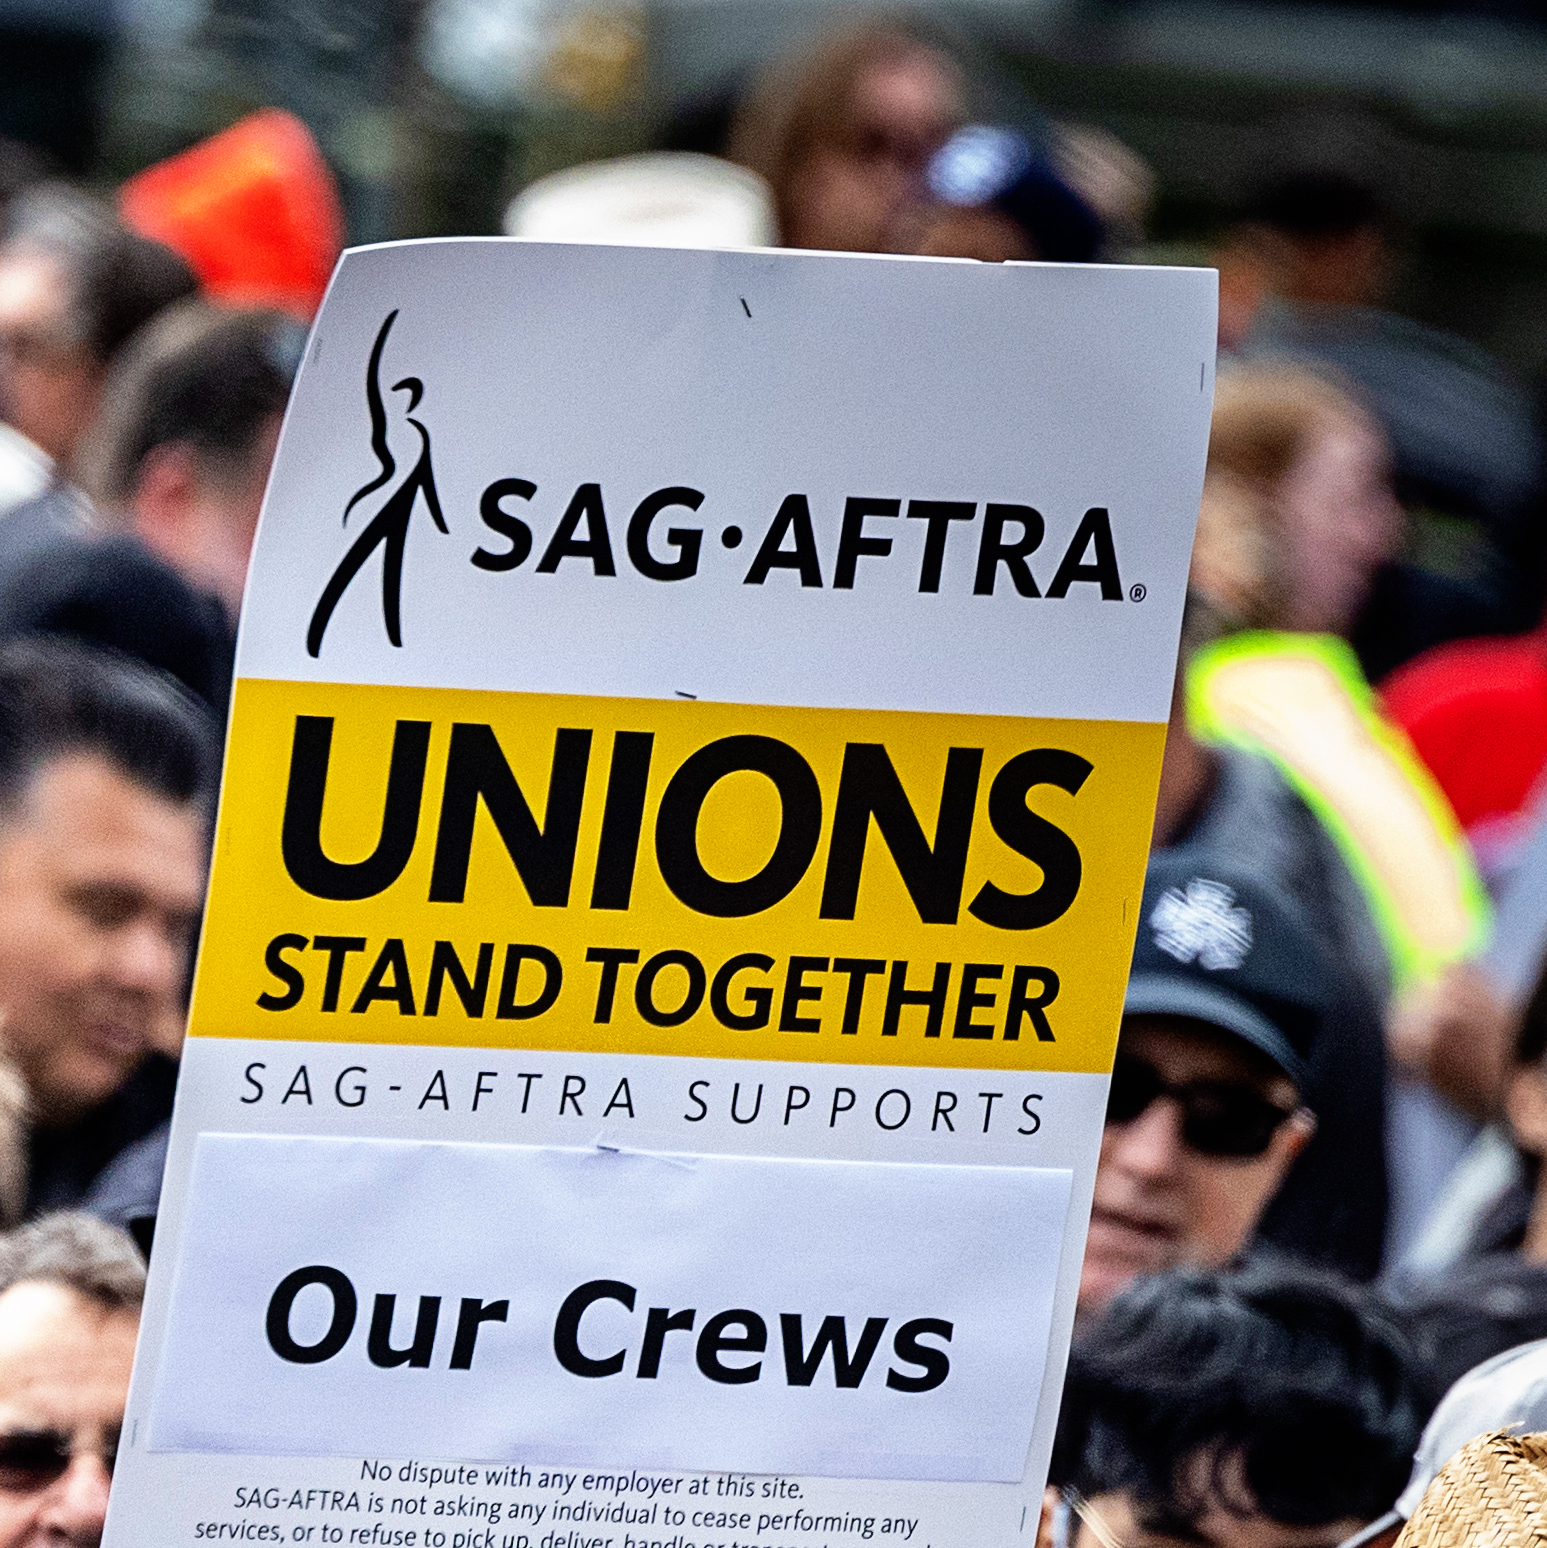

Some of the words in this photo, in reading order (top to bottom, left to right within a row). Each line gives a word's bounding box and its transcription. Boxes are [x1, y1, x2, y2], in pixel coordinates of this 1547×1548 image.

[281, 714, 1095, 931] UNIONS
[255, 932, 563, 1021] STAND
[585, 947, 1061, 1043] TOGETHER
[240, 1062, 636, 1119] SAG-AFTRA
[684, 1080, 1044, 1135] SUPPORTS
[265, 1265, 510, 1372] Our
[553, 1279, 954, 1393] Crews
[233, 1487, 360, 1513] SAG-AFTRA
[367, 1491, 384, 1513] is
[390, 1496, 427, 1516] not
[433, 1495, 503, 1524] asking
[508, 1502, 548, 1526] any
[552, 1501, 657, 1526] individual
[663, 1507, 685, 1527] to
[692, 1511, 751, 1530] cease
[757, 1509, 876, 1539] performing
[881, 1518, 918, 1540] any
[360, 1460, 393, 1482] No
[398, 1461, 479, 1486] dispute
[485, 1465, 531, 1488] with
[538, 1475, 576, 1493] any
[582, 1471, 684, 1499] employer
[688, 1476, 710, 1497] at
[716, 1475, 756, 1498] this
[760, 1478, 805, 1500] site.
[194, 1519, 285, 1544] services,
[292, 1526, 316, 1543] or
[321, 1524, 343, 1543] to
[349, 1523, 417, 1547] refuse
[424, 1529, 447, 1548] to
